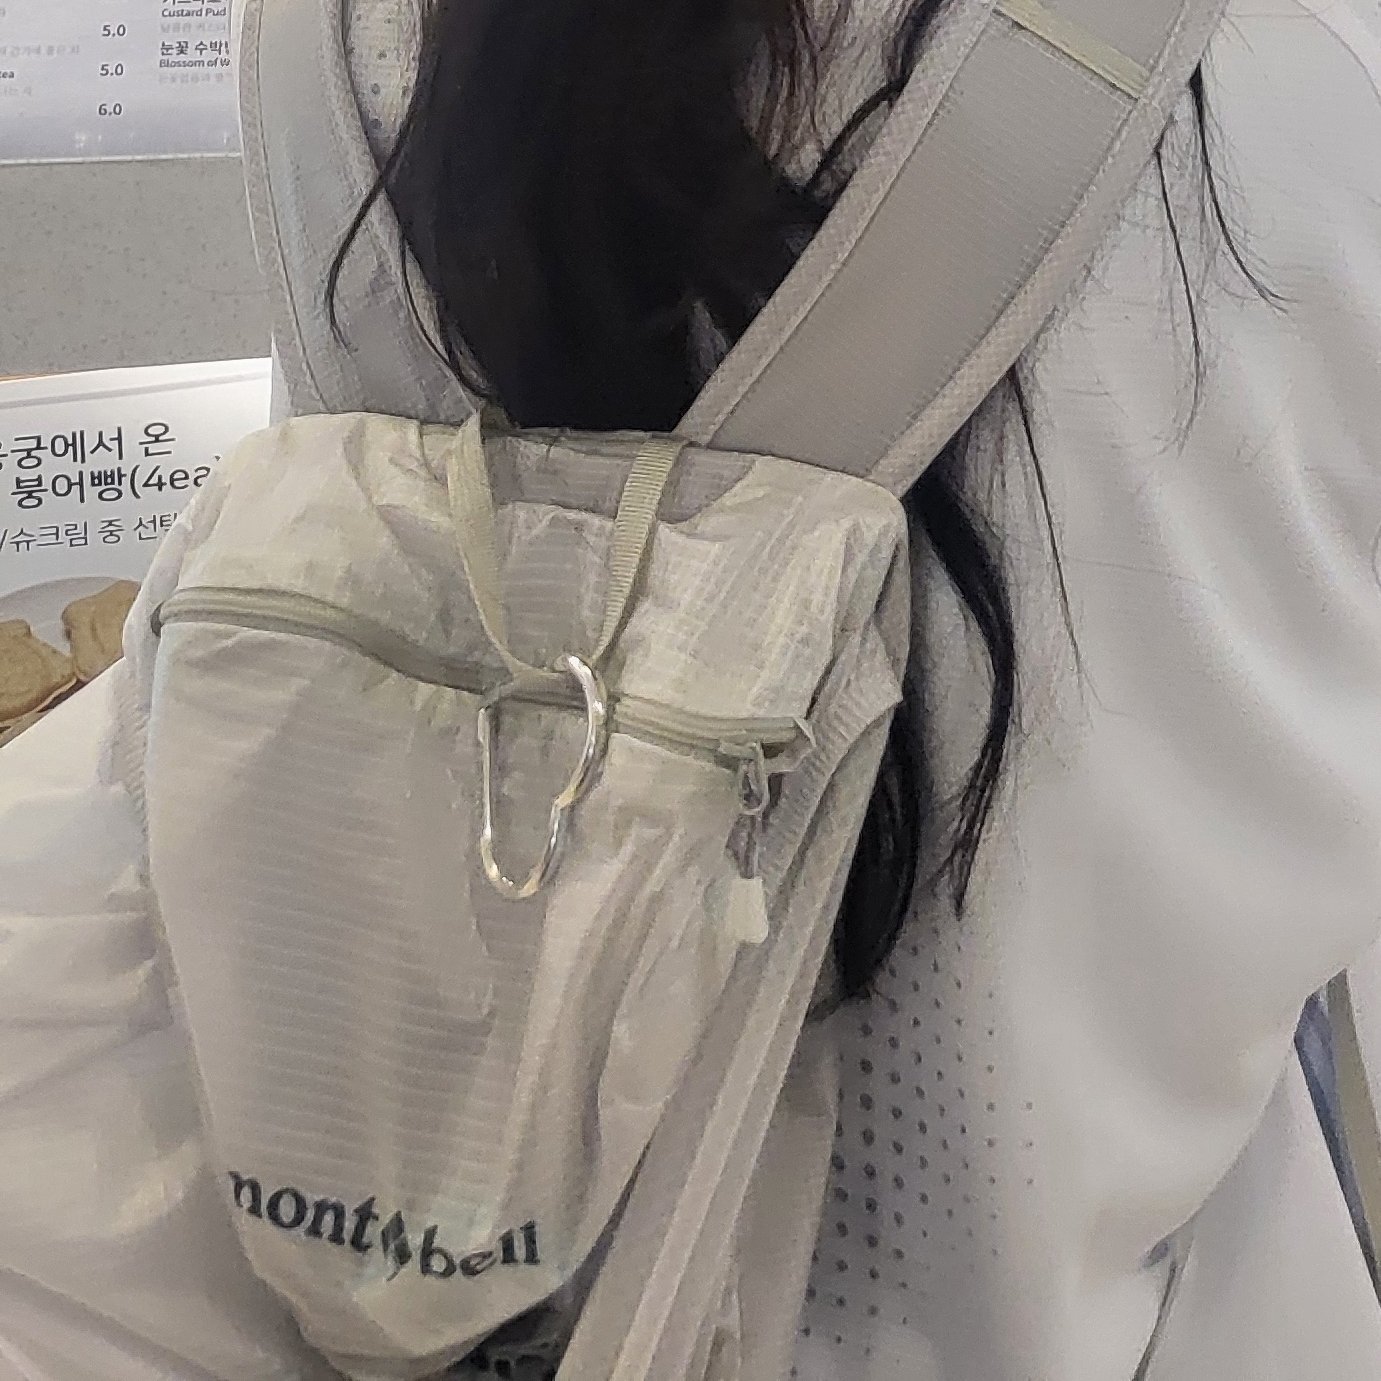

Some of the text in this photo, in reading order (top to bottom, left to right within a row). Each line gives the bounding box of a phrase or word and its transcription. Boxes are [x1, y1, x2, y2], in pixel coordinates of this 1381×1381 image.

[161, 7, 202, 18] Custard
[101, 23, 127, 38] 5.0
[160, 40, 189, 56] 눈꽃
[99, 62, 124, 77] 5.0
[159, 58, 205, 69] Blossom
[98, 102, 123, 117] 6.0
[138, 422, 177, 458] 온
[97, 518, 125, 544] 중
